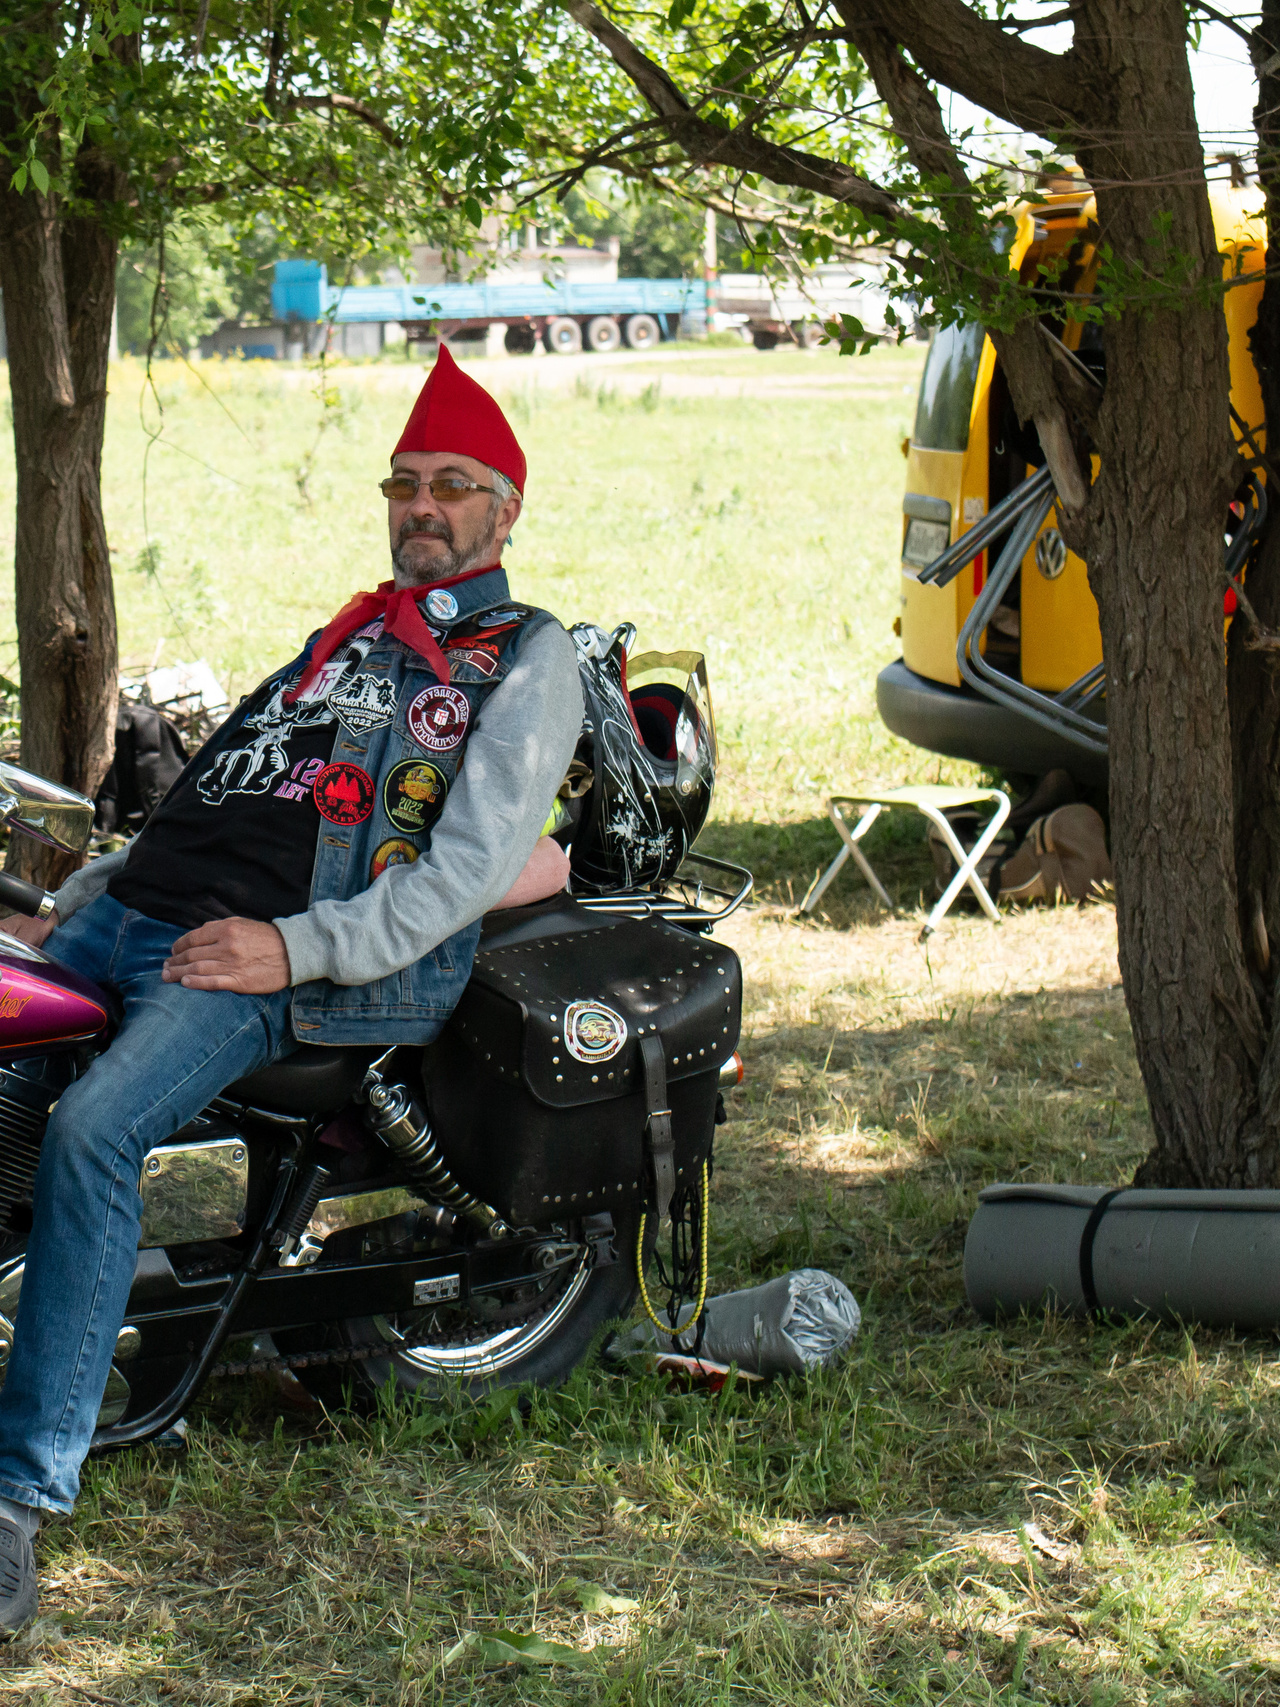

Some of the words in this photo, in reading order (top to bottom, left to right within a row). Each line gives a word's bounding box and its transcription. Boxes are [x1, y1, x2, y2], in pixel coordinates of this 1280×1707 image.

[346, 716, 372, 728] 2022
[457, 700, 467, 722] 2022
[290, 757, 326, 786] 12
[318, 766, 341, 787] ОСТРОВ
[343, 766, 372, 797] СВОБОДЫ
[273, 780, 311, 802] ЛЕТ
[317, 791, 372, 823] ГУЛЬКЕВИЧИ
[398, 796, 424, 815] 2022
